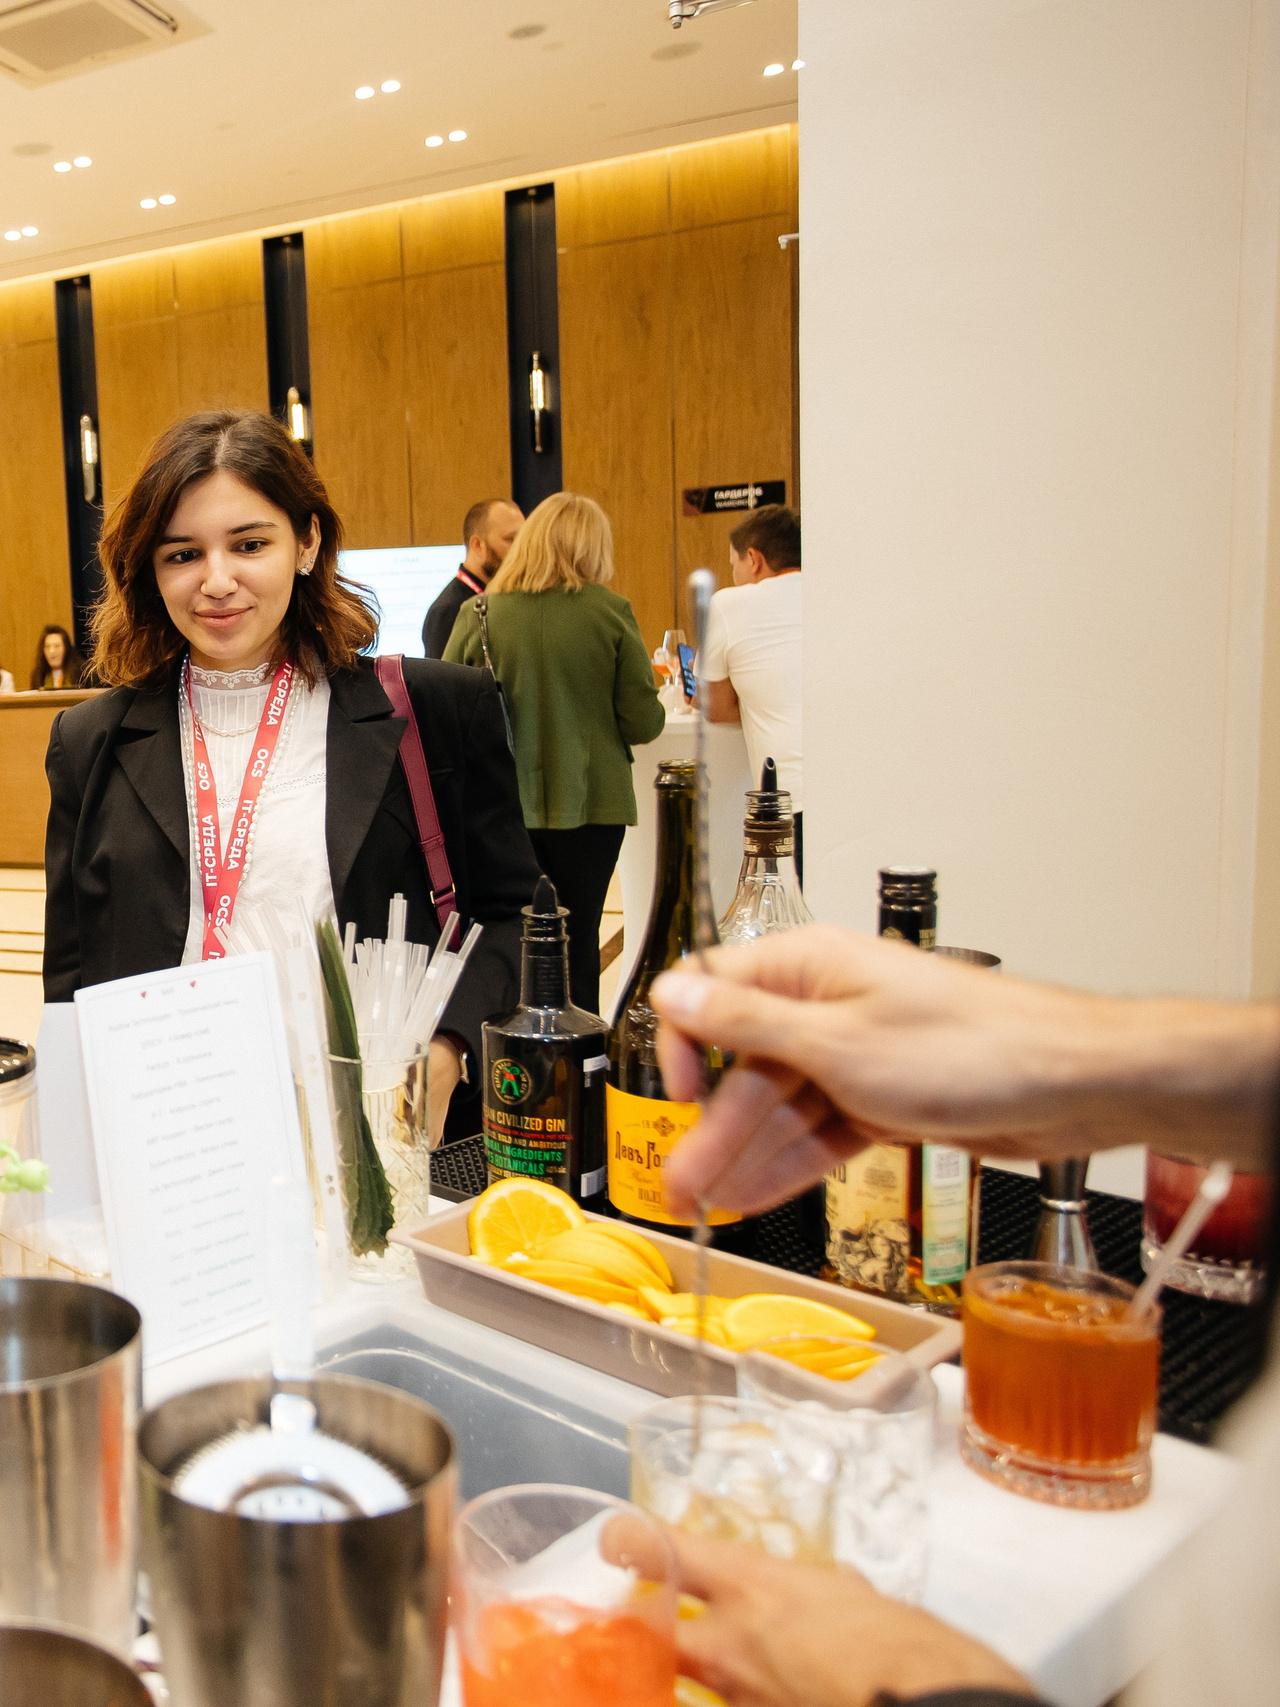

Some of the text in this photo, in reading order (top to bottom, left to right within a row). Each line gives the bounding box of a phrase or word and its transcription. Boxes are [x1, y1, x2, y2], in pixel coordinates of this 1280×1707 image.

[266, 662, 293, 726] IT-СРЕДА
[198, 761, 210, 791] OCS
[251, 748, 269, 778] OCS
[227, 799, 254, 871] IT-СРЕДА
[202, 814, 217, 887] IT-СРЕДА
[215, 895, 231, 927] OCS
[496, 1111, 543, 1131] CIVILIZED
[546, 1118, 565, 1132] GIN
[502, 1145, 562, 1162] INGREDIENTS
[528, 1140, 567, 1150] AMBITIOUS
[494, 1153, 544, 1176] BOTANICALS
